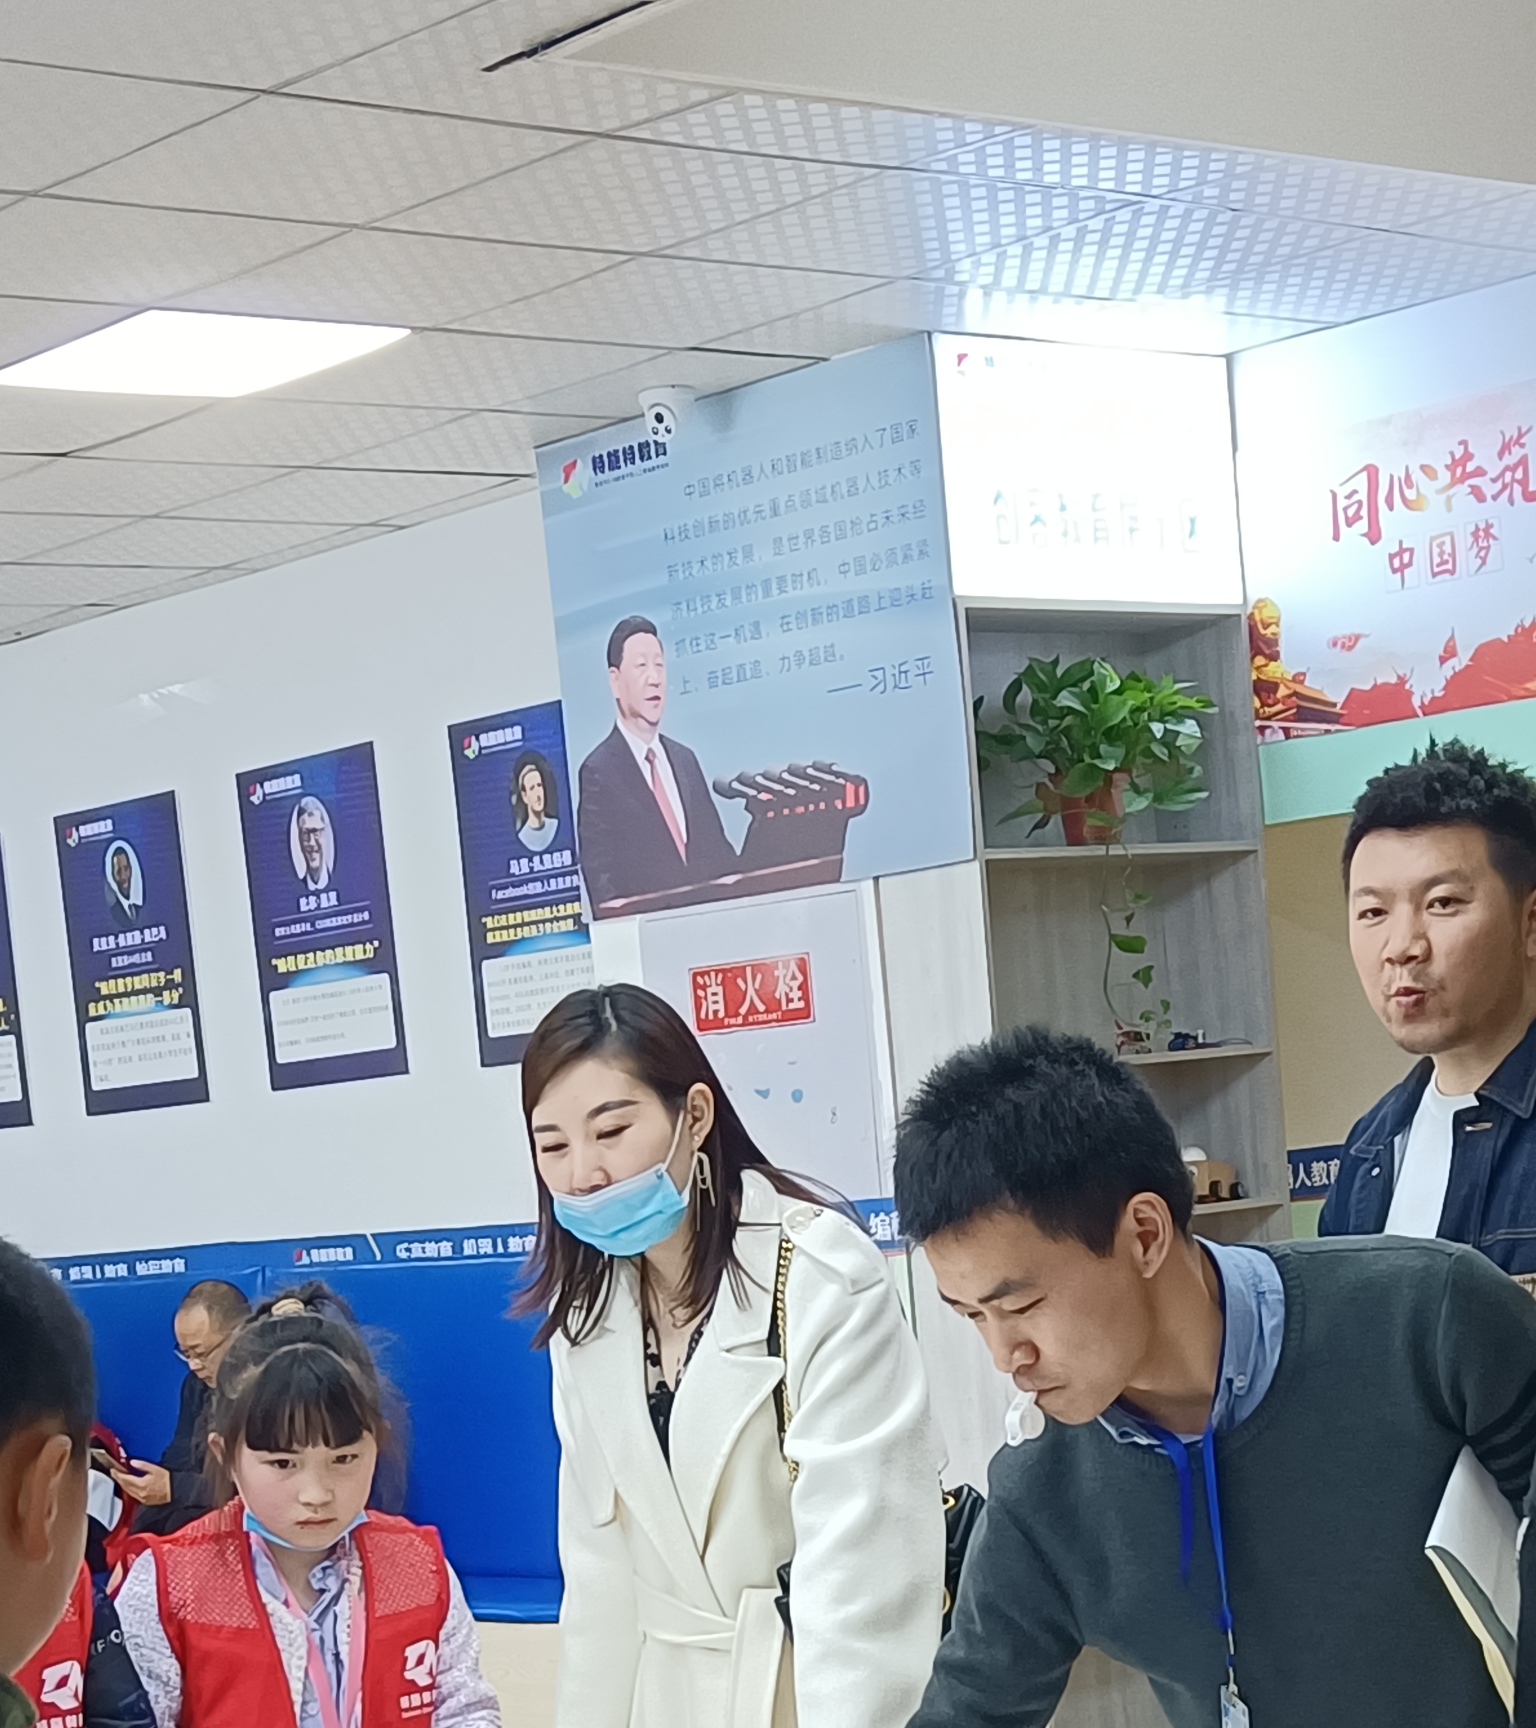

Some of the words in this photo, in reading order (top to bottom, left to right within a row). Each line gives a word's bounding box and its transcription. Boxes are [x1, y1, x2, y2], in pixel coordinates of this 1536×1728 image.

[1388, 519, 1500, 590] 中国梦
[696, 959, 806, 1021] 消火栓
